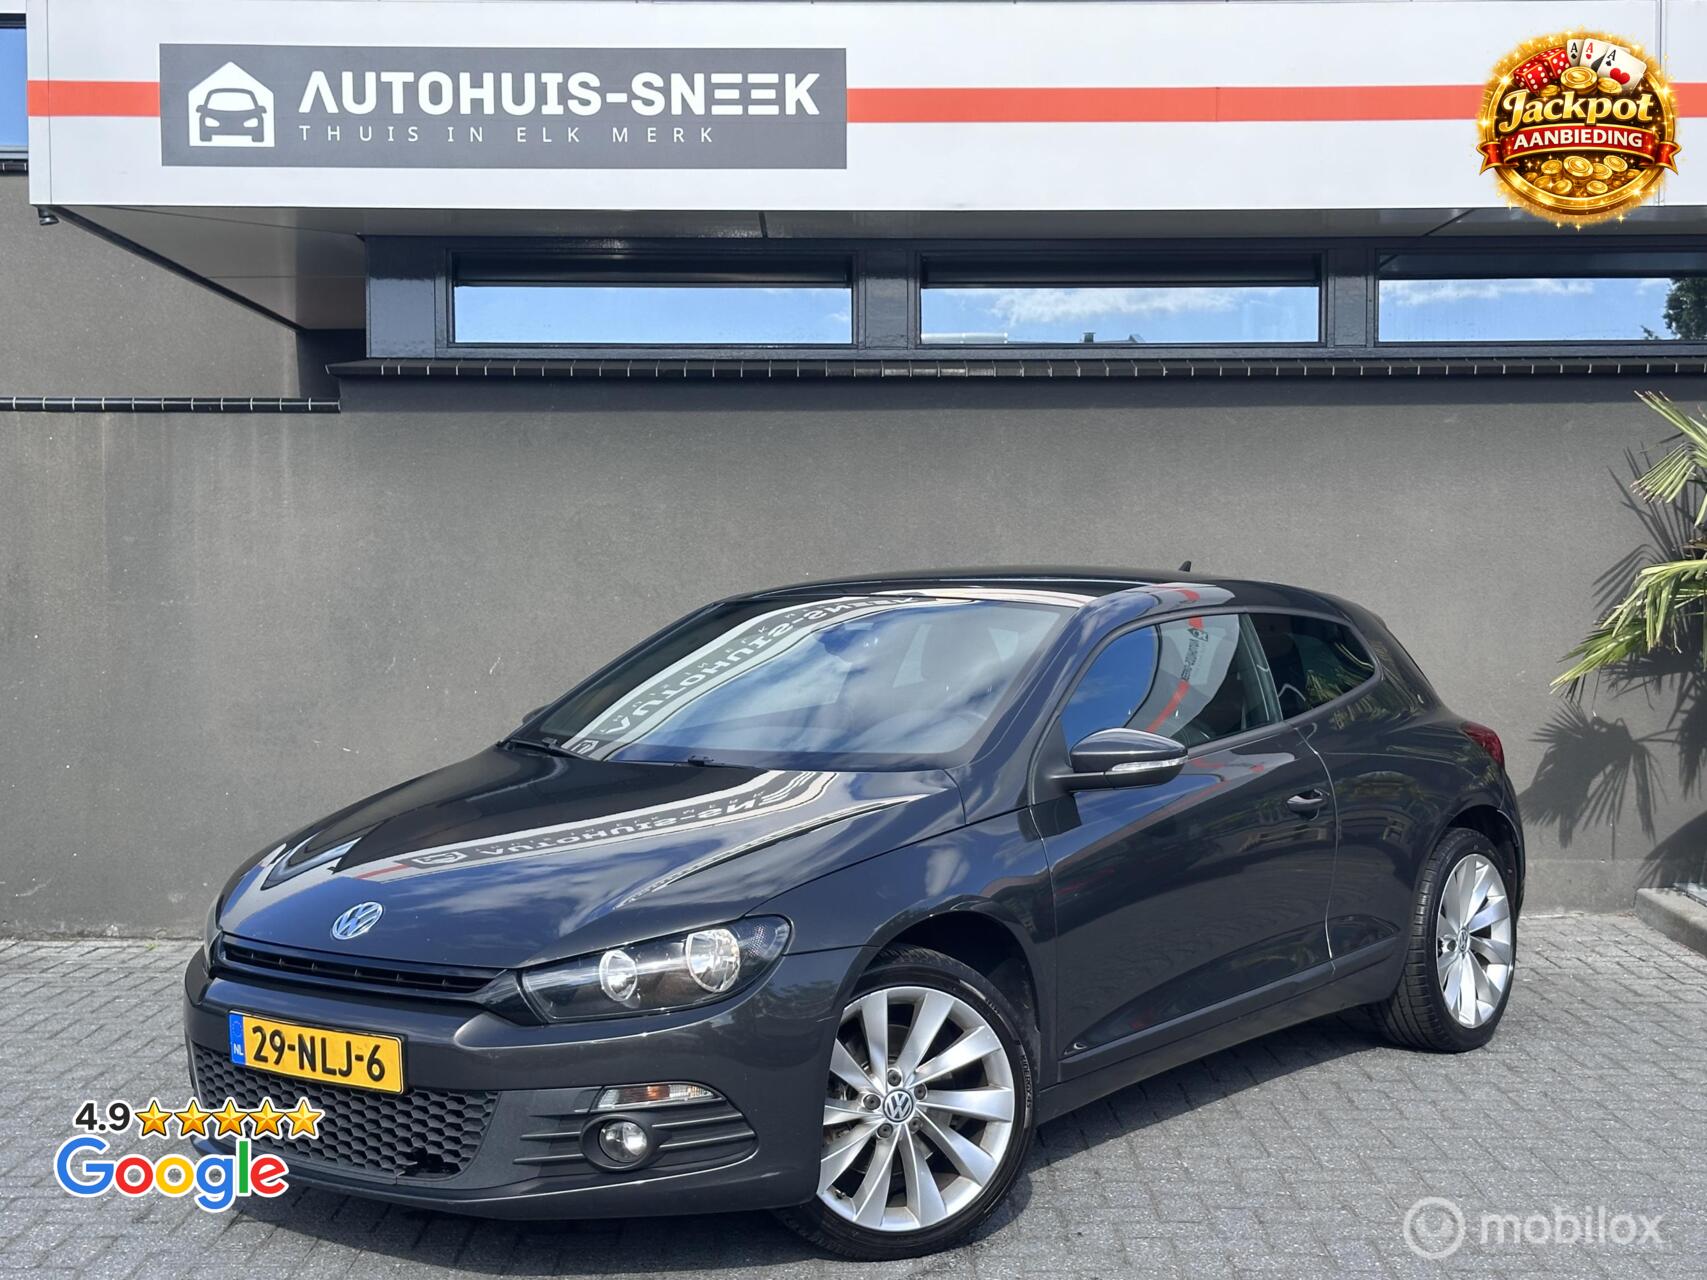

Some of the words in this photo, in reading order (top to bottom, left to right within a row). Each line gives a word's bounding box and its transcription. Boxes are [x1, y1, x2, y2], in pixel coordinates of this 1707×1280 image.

[298, 70, 821, 117] AUTOHUIS-SNEEK
[298, 124, 419, 142] THUIS
[447, 126, 483, 143] IN
[516, 126, 580, 143] ELK
[612, 126, 713, 143] MERK
[232, 1043, 245, 1056] NL
[251, 1025, 386, 1082] 29-NLJ-6
